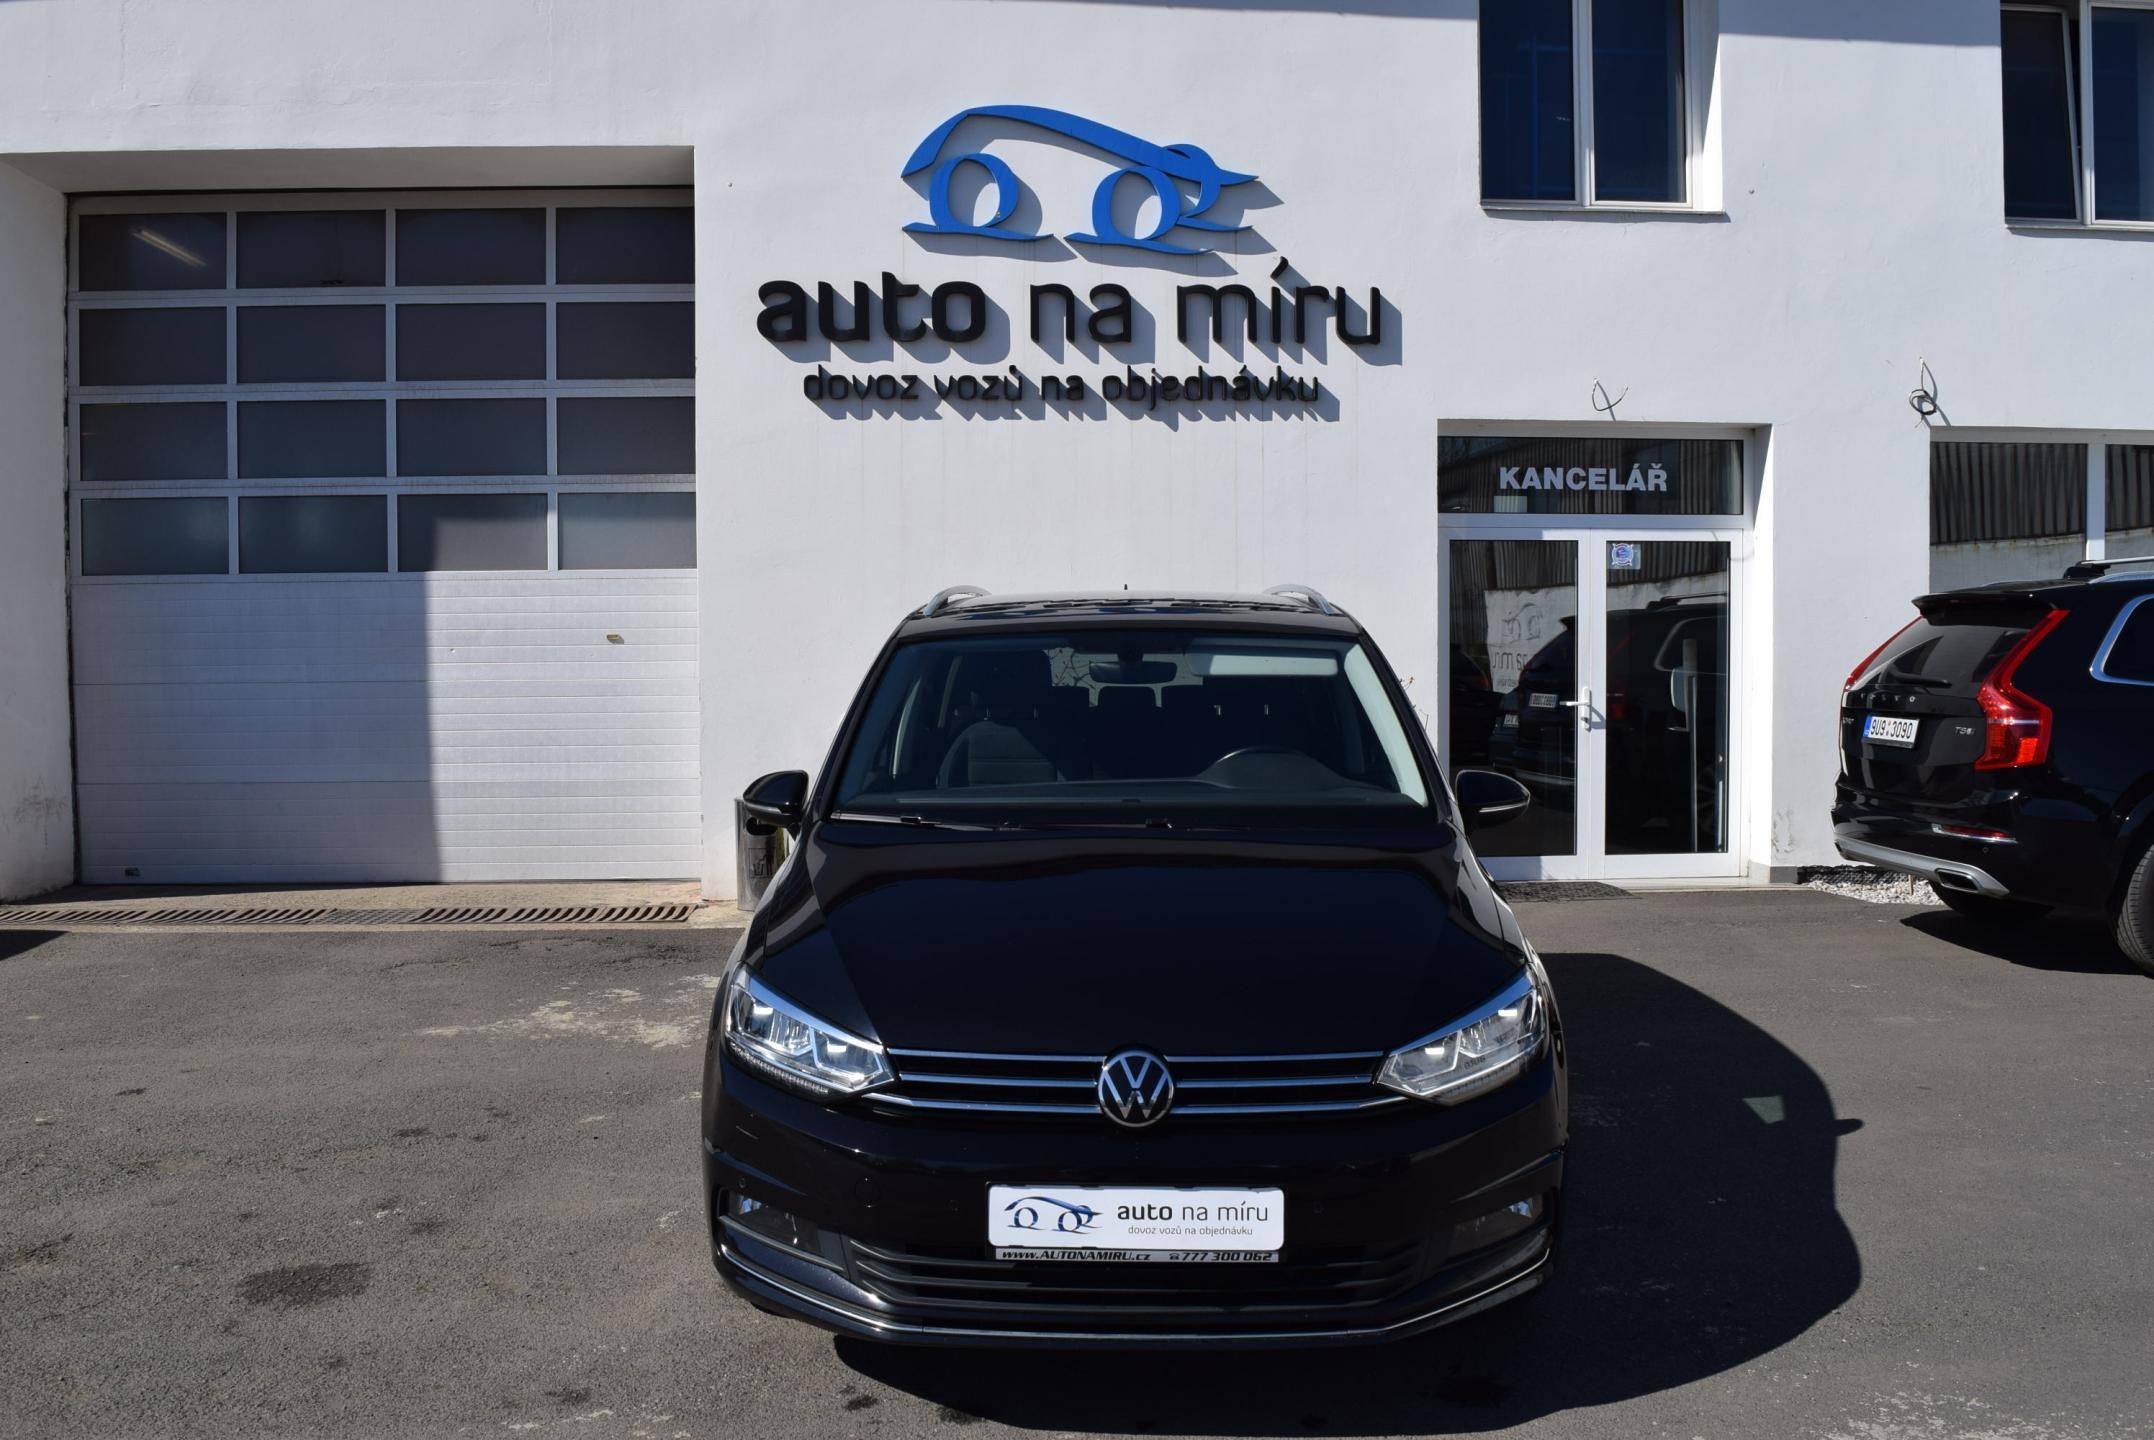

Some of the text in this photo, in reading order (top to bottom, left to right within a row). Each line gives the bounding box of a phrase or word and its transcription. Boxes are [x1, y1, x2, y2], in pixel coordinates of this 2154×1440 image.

[757, 256, 1381, 345] auto na míru
[803, 364, 920, 401] dovoz
[1041, 374, 1085, 401] na
[1101, 364, 1319, 412] objednávku
[1499, 463, 1668, 492] KANCELÁŘ
[1890, 721, 1914, 740] 3090
[1117, 1200, 1269, 1222] auto na míru
[1127, 1225, 1254, 1237] dovoz vozů na objednávku
[1182, 1252, 1209, 1261] 777
[1210, 1252, 1240, 1261] 300
[1243, 1252, 1274, 1261] 062
